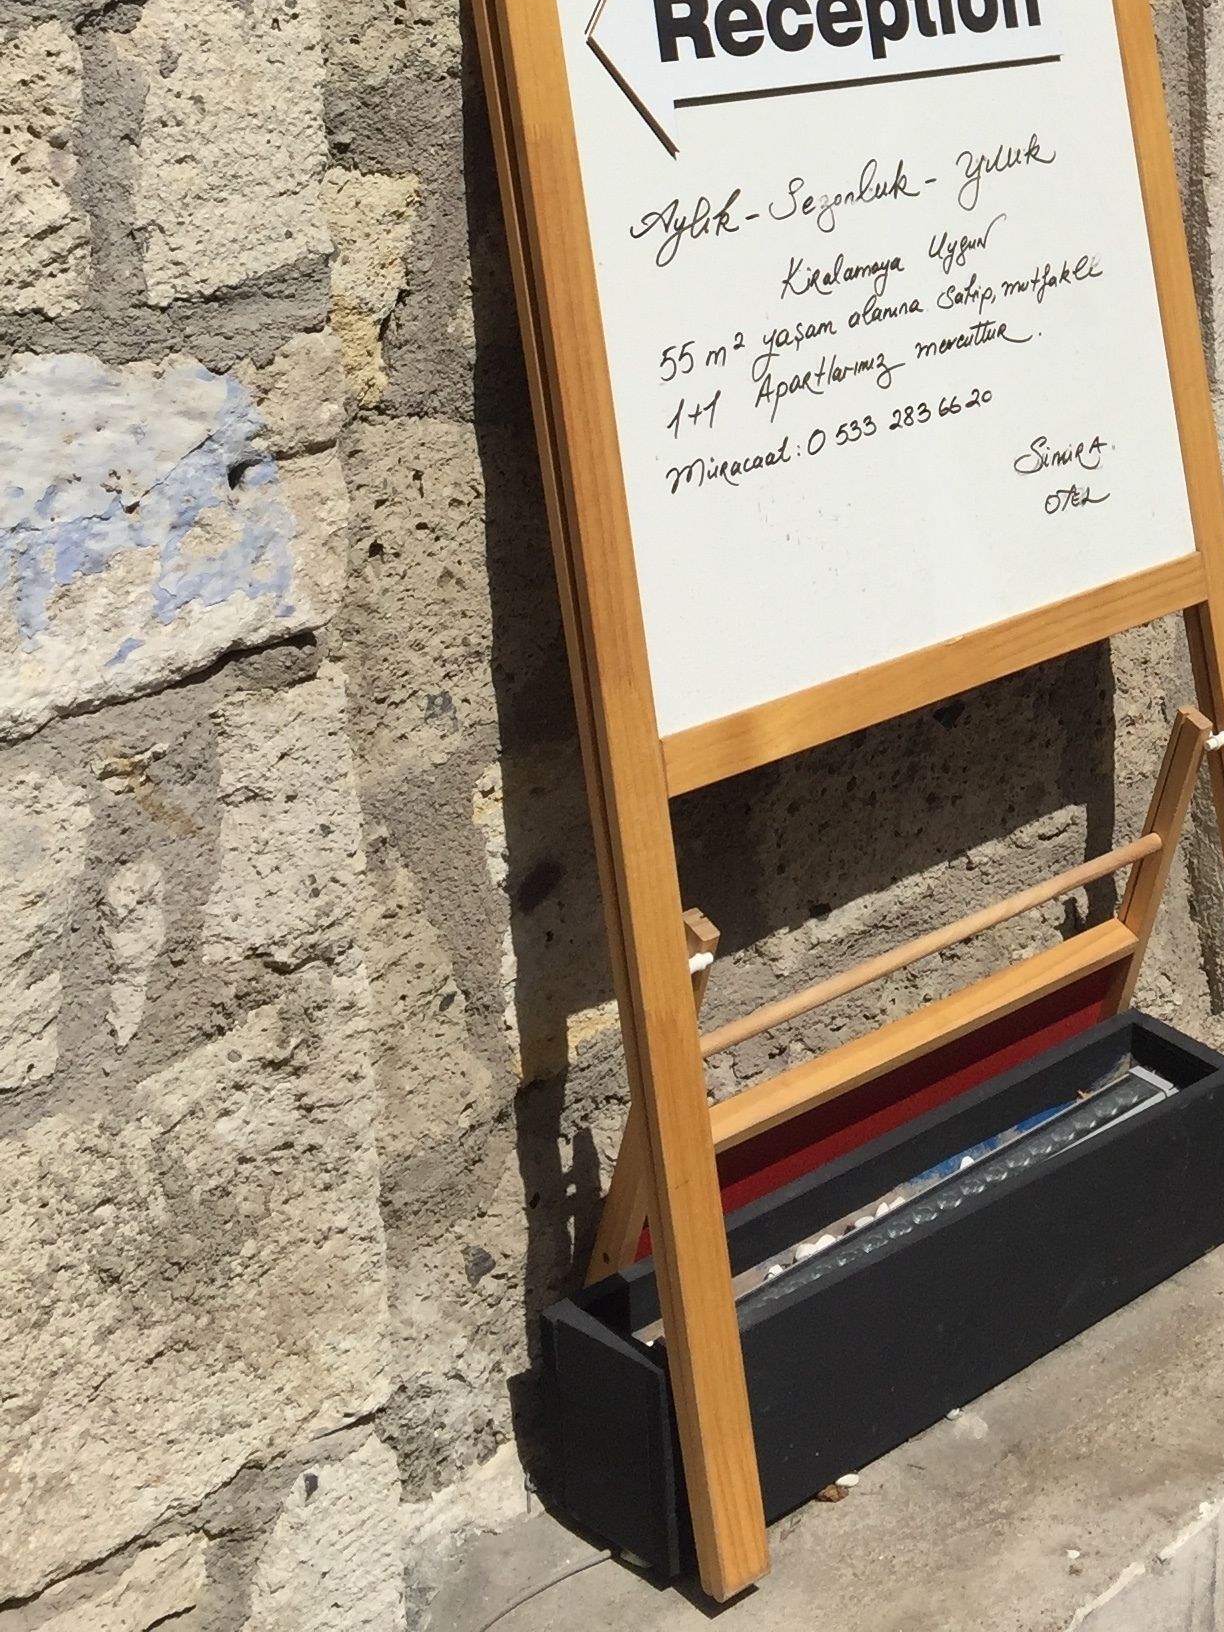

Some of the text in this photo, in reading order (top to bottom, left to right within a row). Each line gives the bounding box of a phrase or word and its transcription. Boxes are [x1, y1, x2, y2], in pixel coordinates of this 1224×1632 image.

[660, 340, 695, 381] 55
[752, 320, 837, 382] yaşam
[667, 390, 721, 439] 1+1
[836, 414, 877, 445] 533
[889, 402, 931, 430] 283
